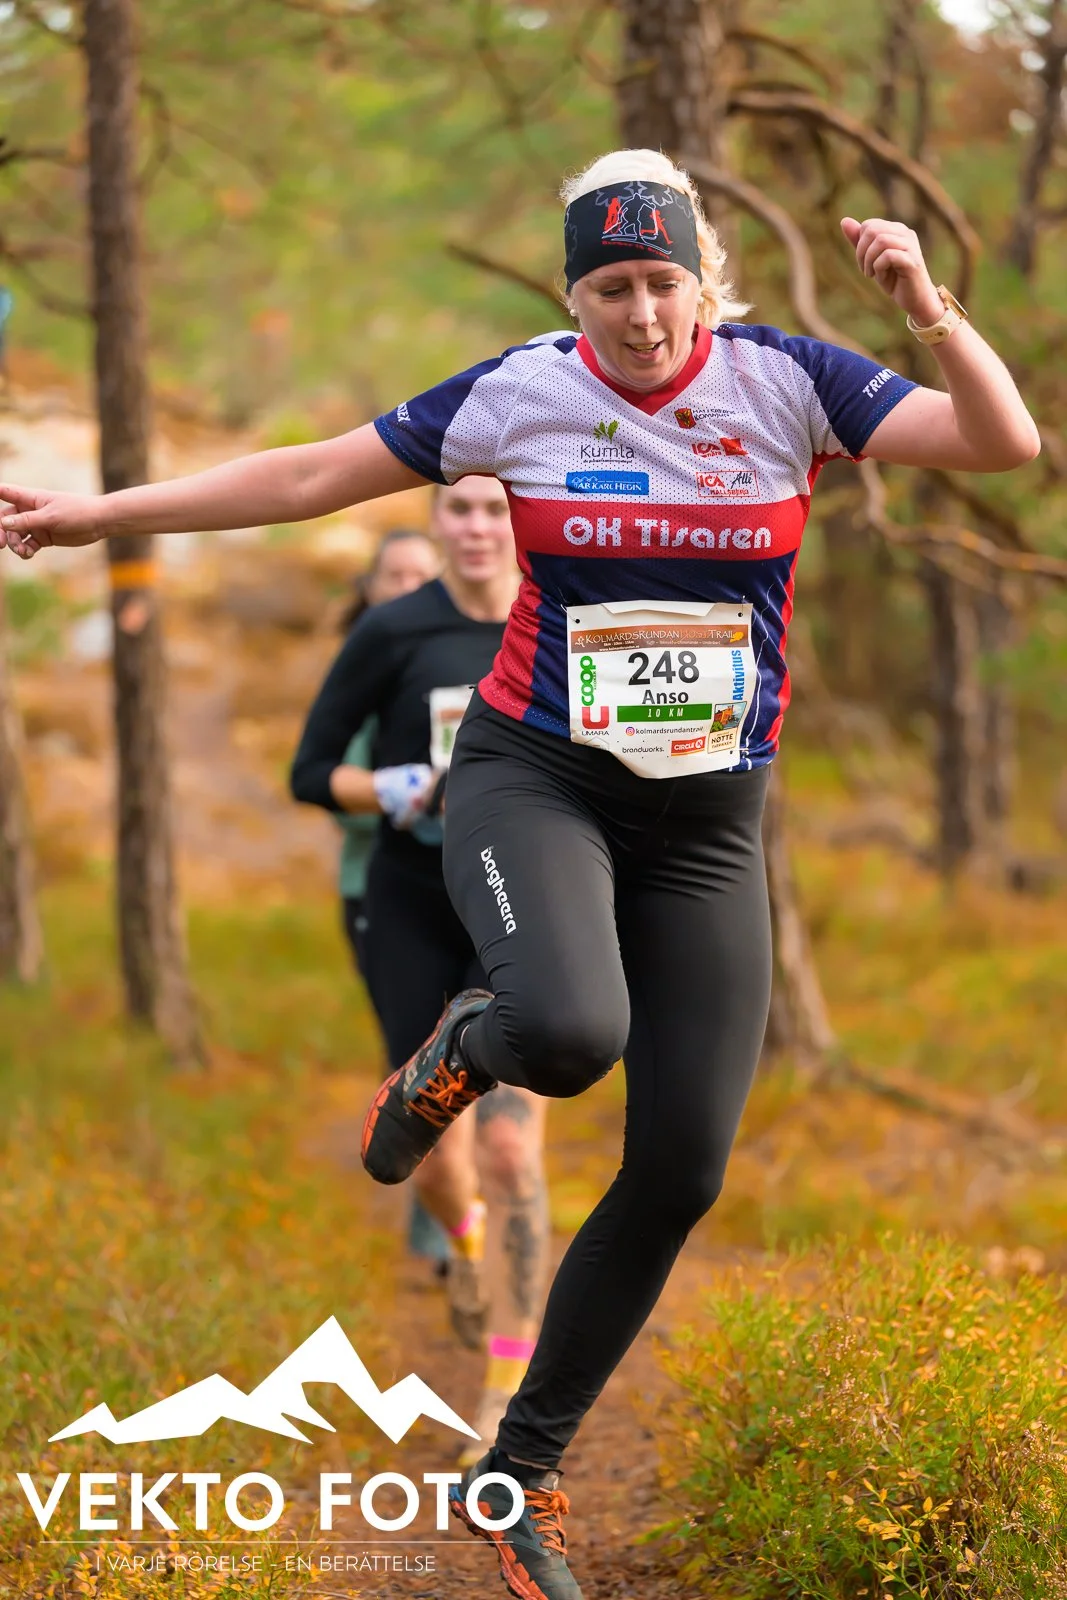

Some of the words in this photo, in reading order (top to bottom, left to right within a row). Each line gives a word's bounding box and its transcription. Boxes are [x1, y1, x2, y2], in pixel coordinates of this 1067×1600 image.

[580, 444, 635, 459] Kumla
[577, 482, 591, 490] AB
[592, 482, 614, 490] KARL
[699, 475, 726, 488] ICA
[563, 516, 622, 546] OK
[635, 518, 772, 549] Tisaren
[628, 650, 699, 685] 248
[731, 650, 745, 700] Aktivitus
[580, 655, 596, 706] coop
[642, 689, 689, 704] Anso
[647, 708, 661, 718] 10
[668, 707, 684, 718] KM
[480, 846, 517, 935] bagheera
